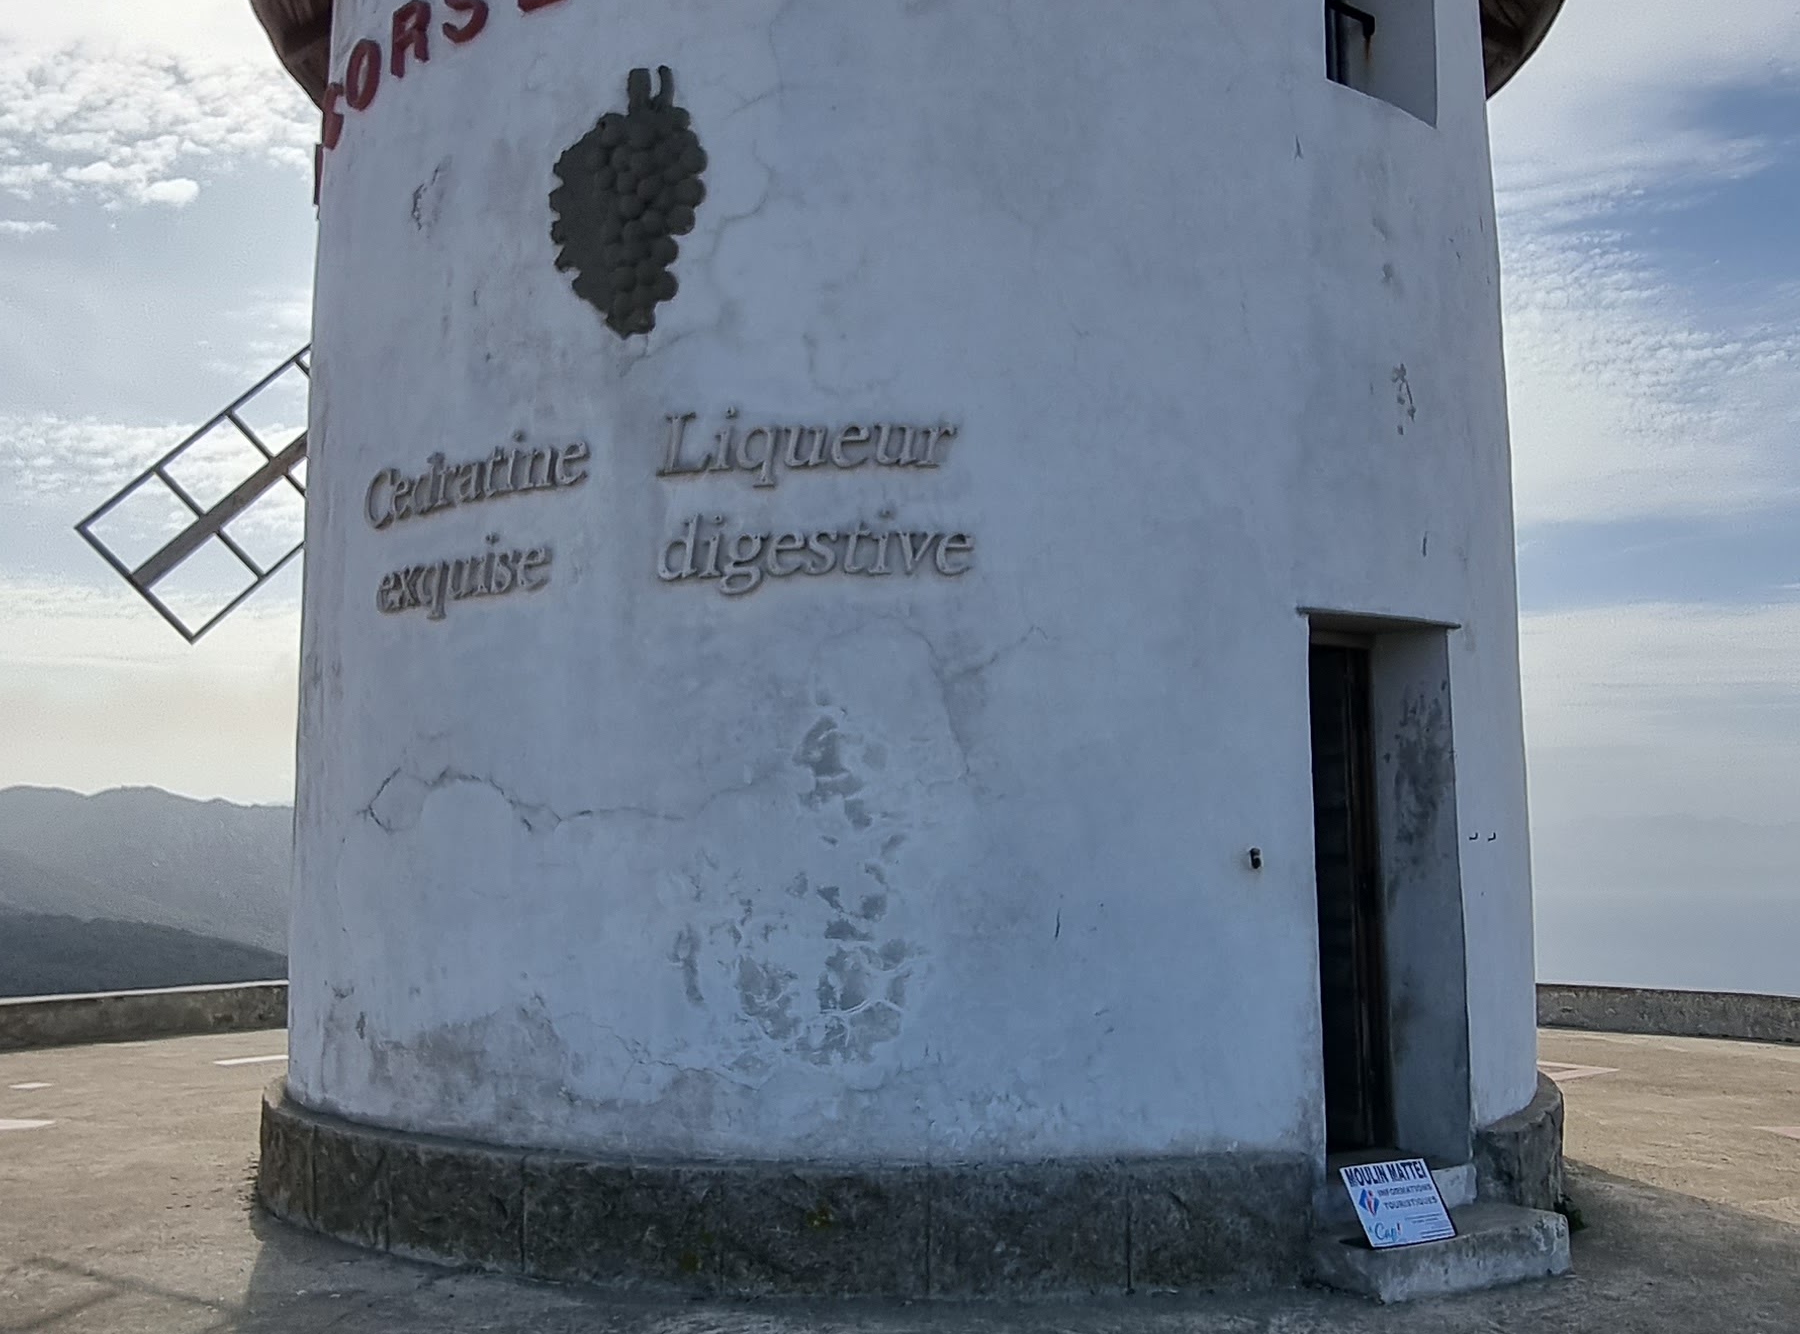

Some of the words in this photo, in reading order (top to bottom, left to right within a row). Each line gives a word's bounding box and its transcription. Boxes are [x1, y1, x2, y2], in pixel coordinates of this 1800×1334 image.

[363, 432, 591, 530] Cedratine
[656, 406, 958, 489] Liqueur
[376, 533, 552, 621] exquise
[656, 509, 975, 596] digestive
[1344, 1165, 1389, 1187] MOULIN
[1386, 1161, 1428, 1182] MATTEI
[1377, 1184, 1433, 1196] INFORMATIONS
[1383, 1196, 1438, 1210] TOURISTIQUES
